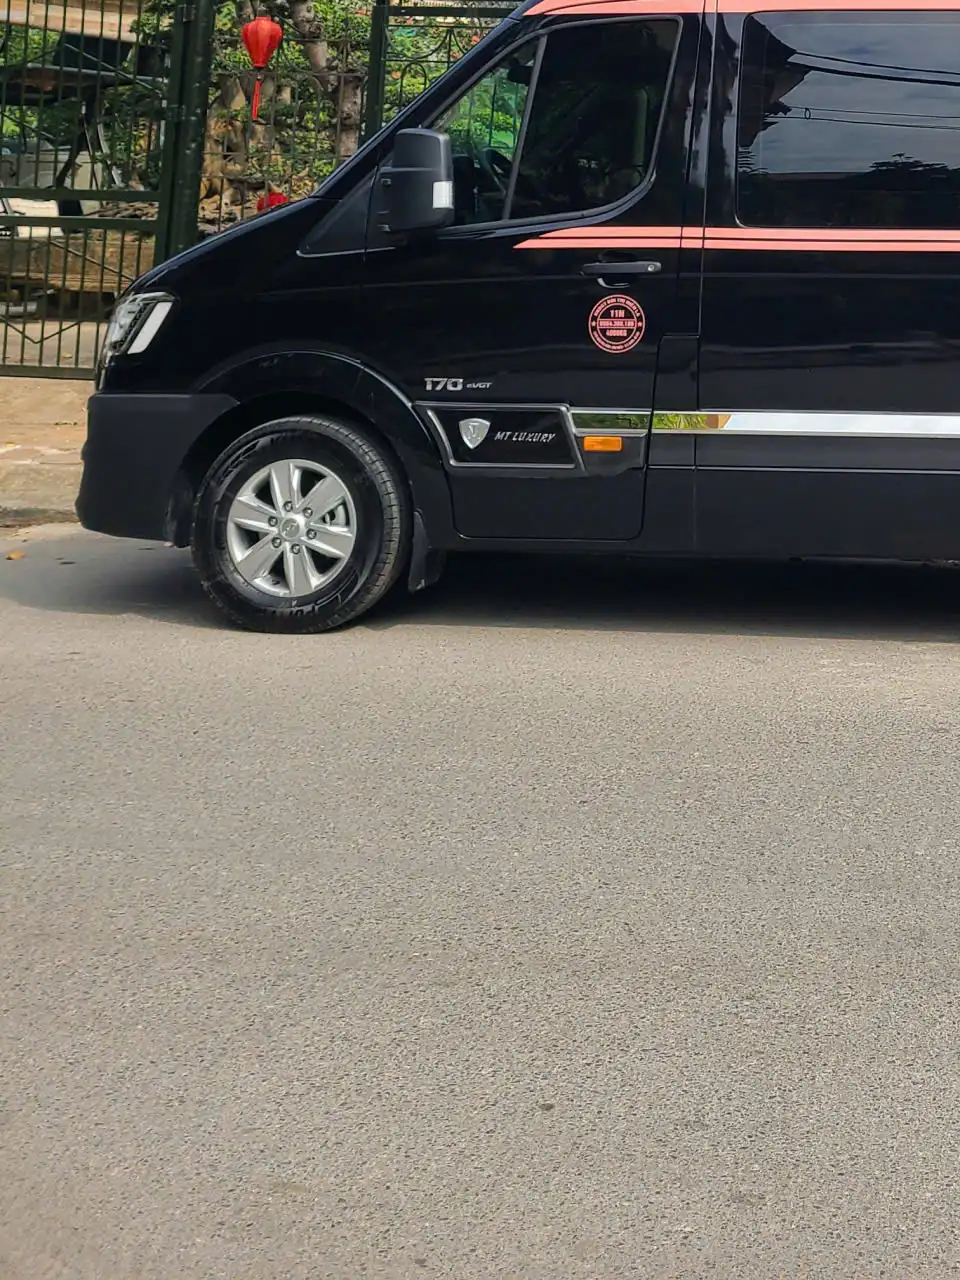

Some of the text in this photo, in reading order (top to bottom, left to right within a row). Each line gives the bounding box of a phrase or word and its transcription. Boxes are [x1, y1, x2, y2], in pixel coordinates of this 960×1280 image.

[424, 377, 464, 391] 170
[494, 431, 556, 443] MT LUXURY
